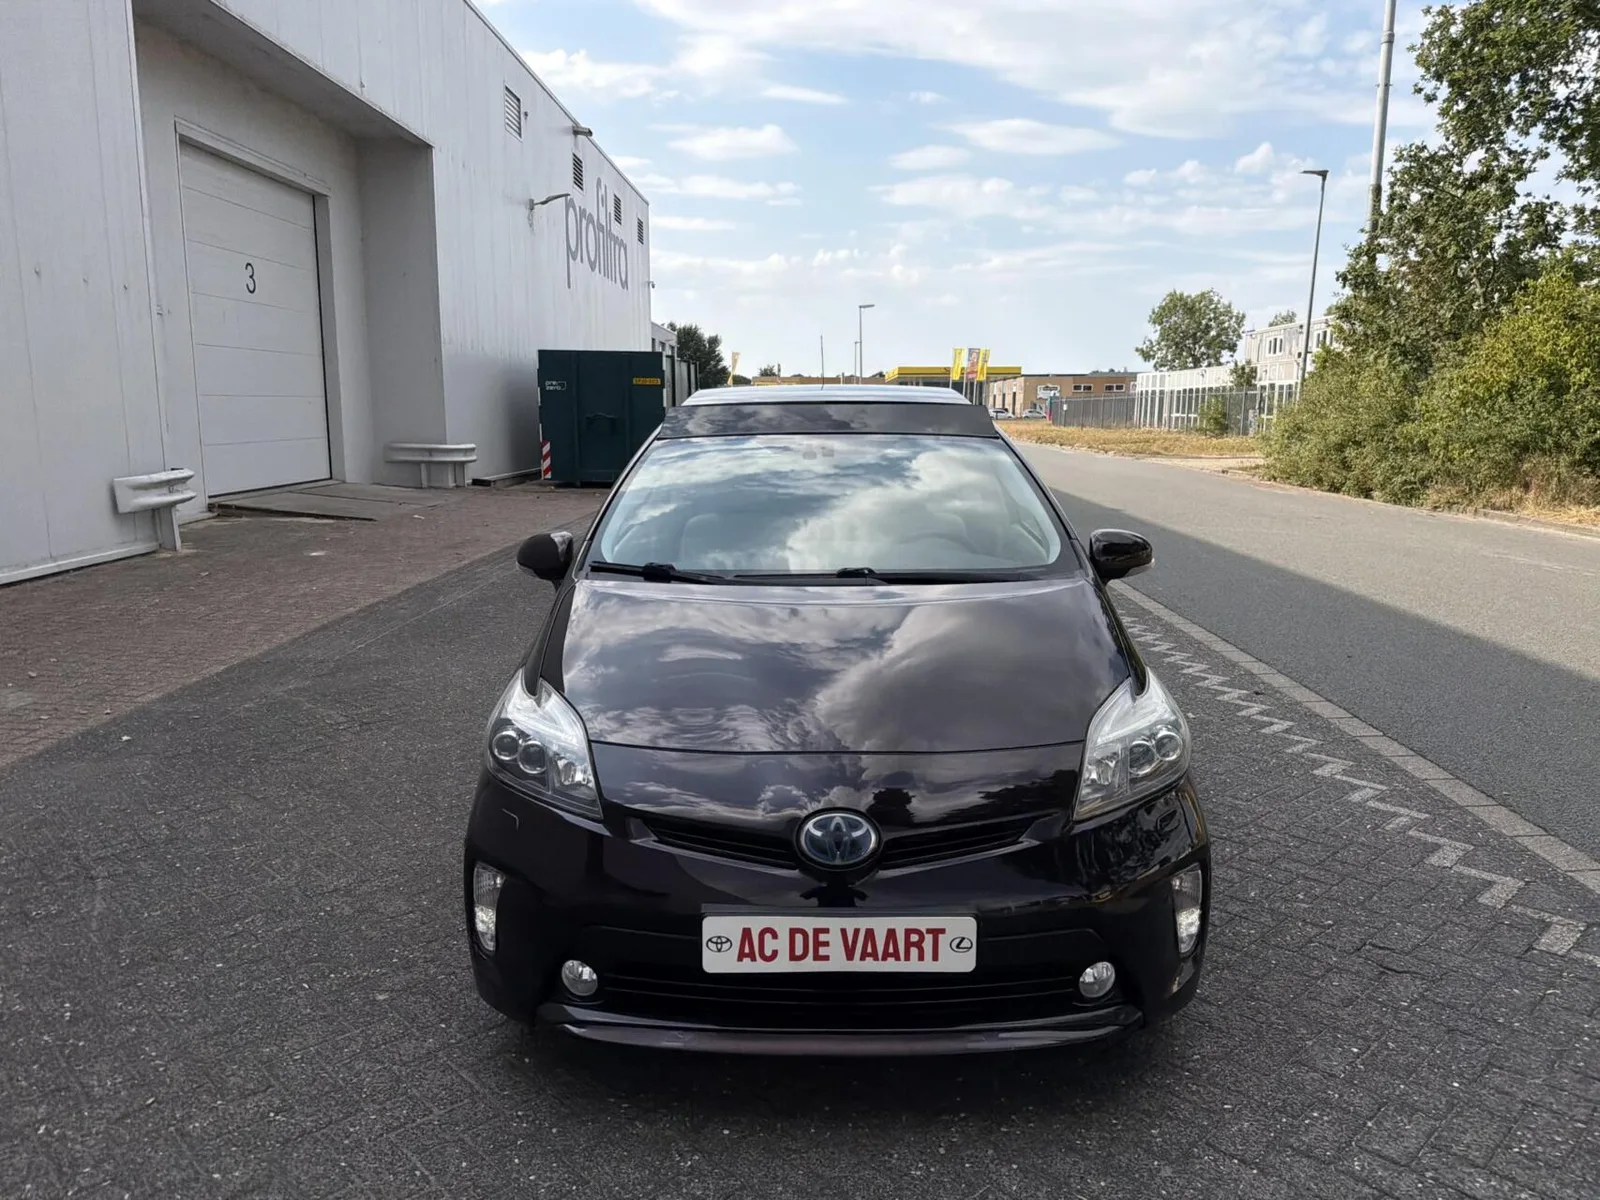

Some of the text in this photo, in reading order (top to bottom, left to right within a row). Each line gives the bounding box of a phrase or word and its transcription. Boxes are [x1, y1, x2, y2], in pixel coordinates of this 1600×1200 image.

[564, 177, 629, 291] profiltra
[245, 262, 256, 294] 3
[737, 927, 946, 962] AC DE VAART
